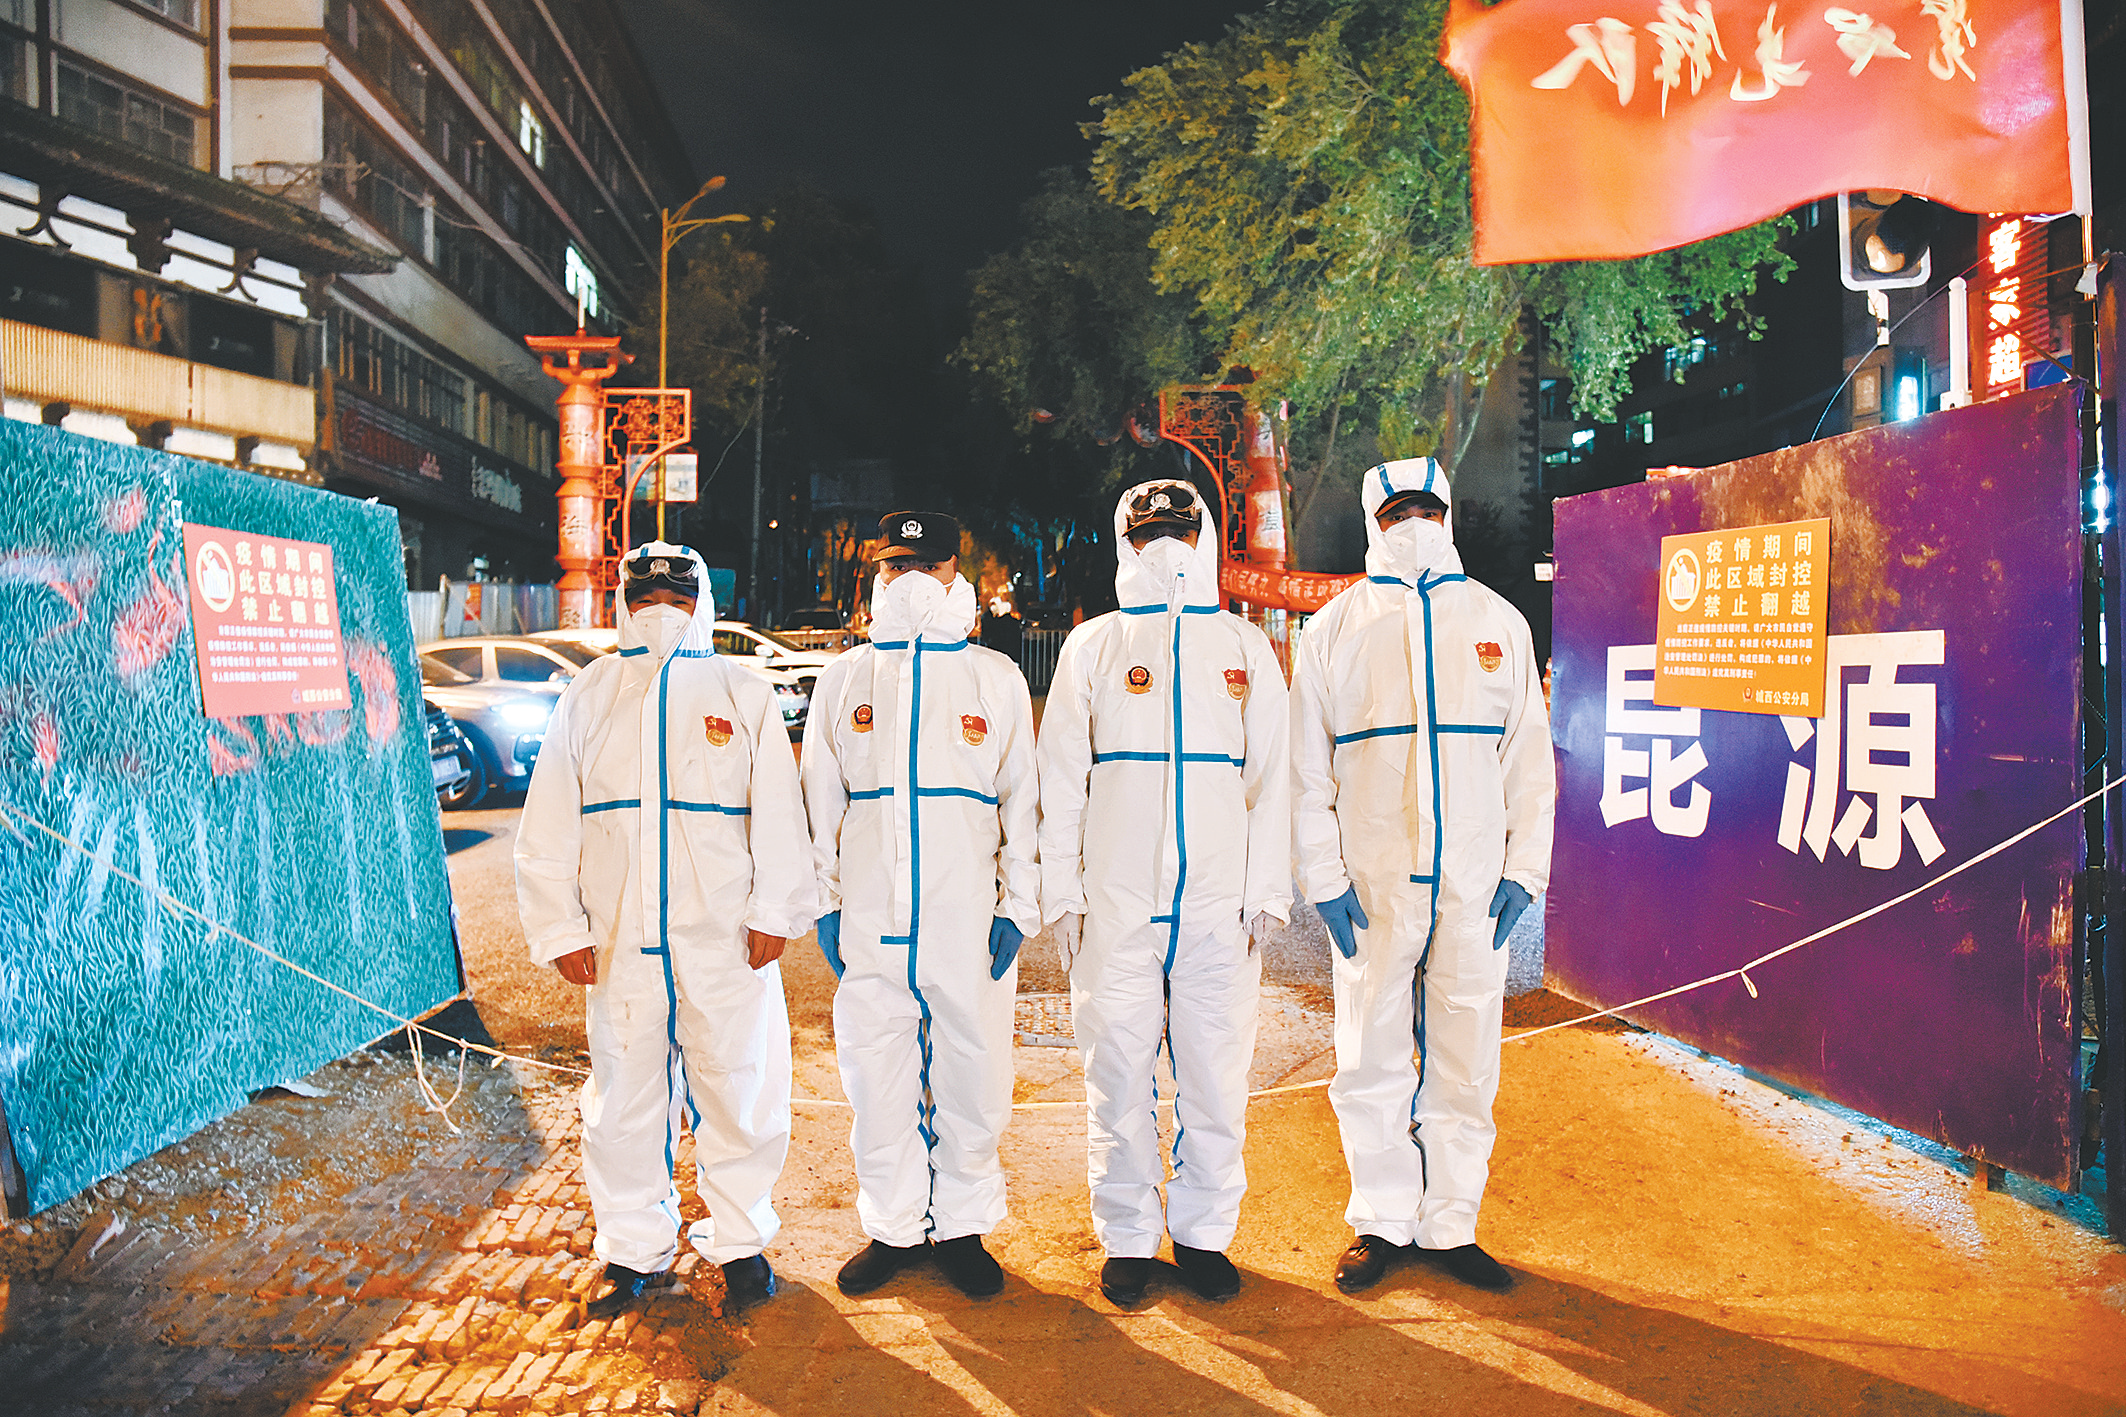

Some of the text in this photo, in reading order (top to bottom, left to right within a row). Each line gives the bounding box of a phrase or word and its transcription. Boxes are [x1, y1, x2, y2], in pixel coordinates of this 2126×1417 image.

[234, 541, 324, 574] 疫情期间
[1706, 531, 1812, 563] 疫情期间
[238, 569, 327, 600] 此区域封控
[1704, 561, 1812, 591] 此区域封控
[1704, 591, 1811, 618] 禁止翻越
[1756, 689, 1810, 707] 城西公安分局
[1599, 629, 1947, 871] 昆源
